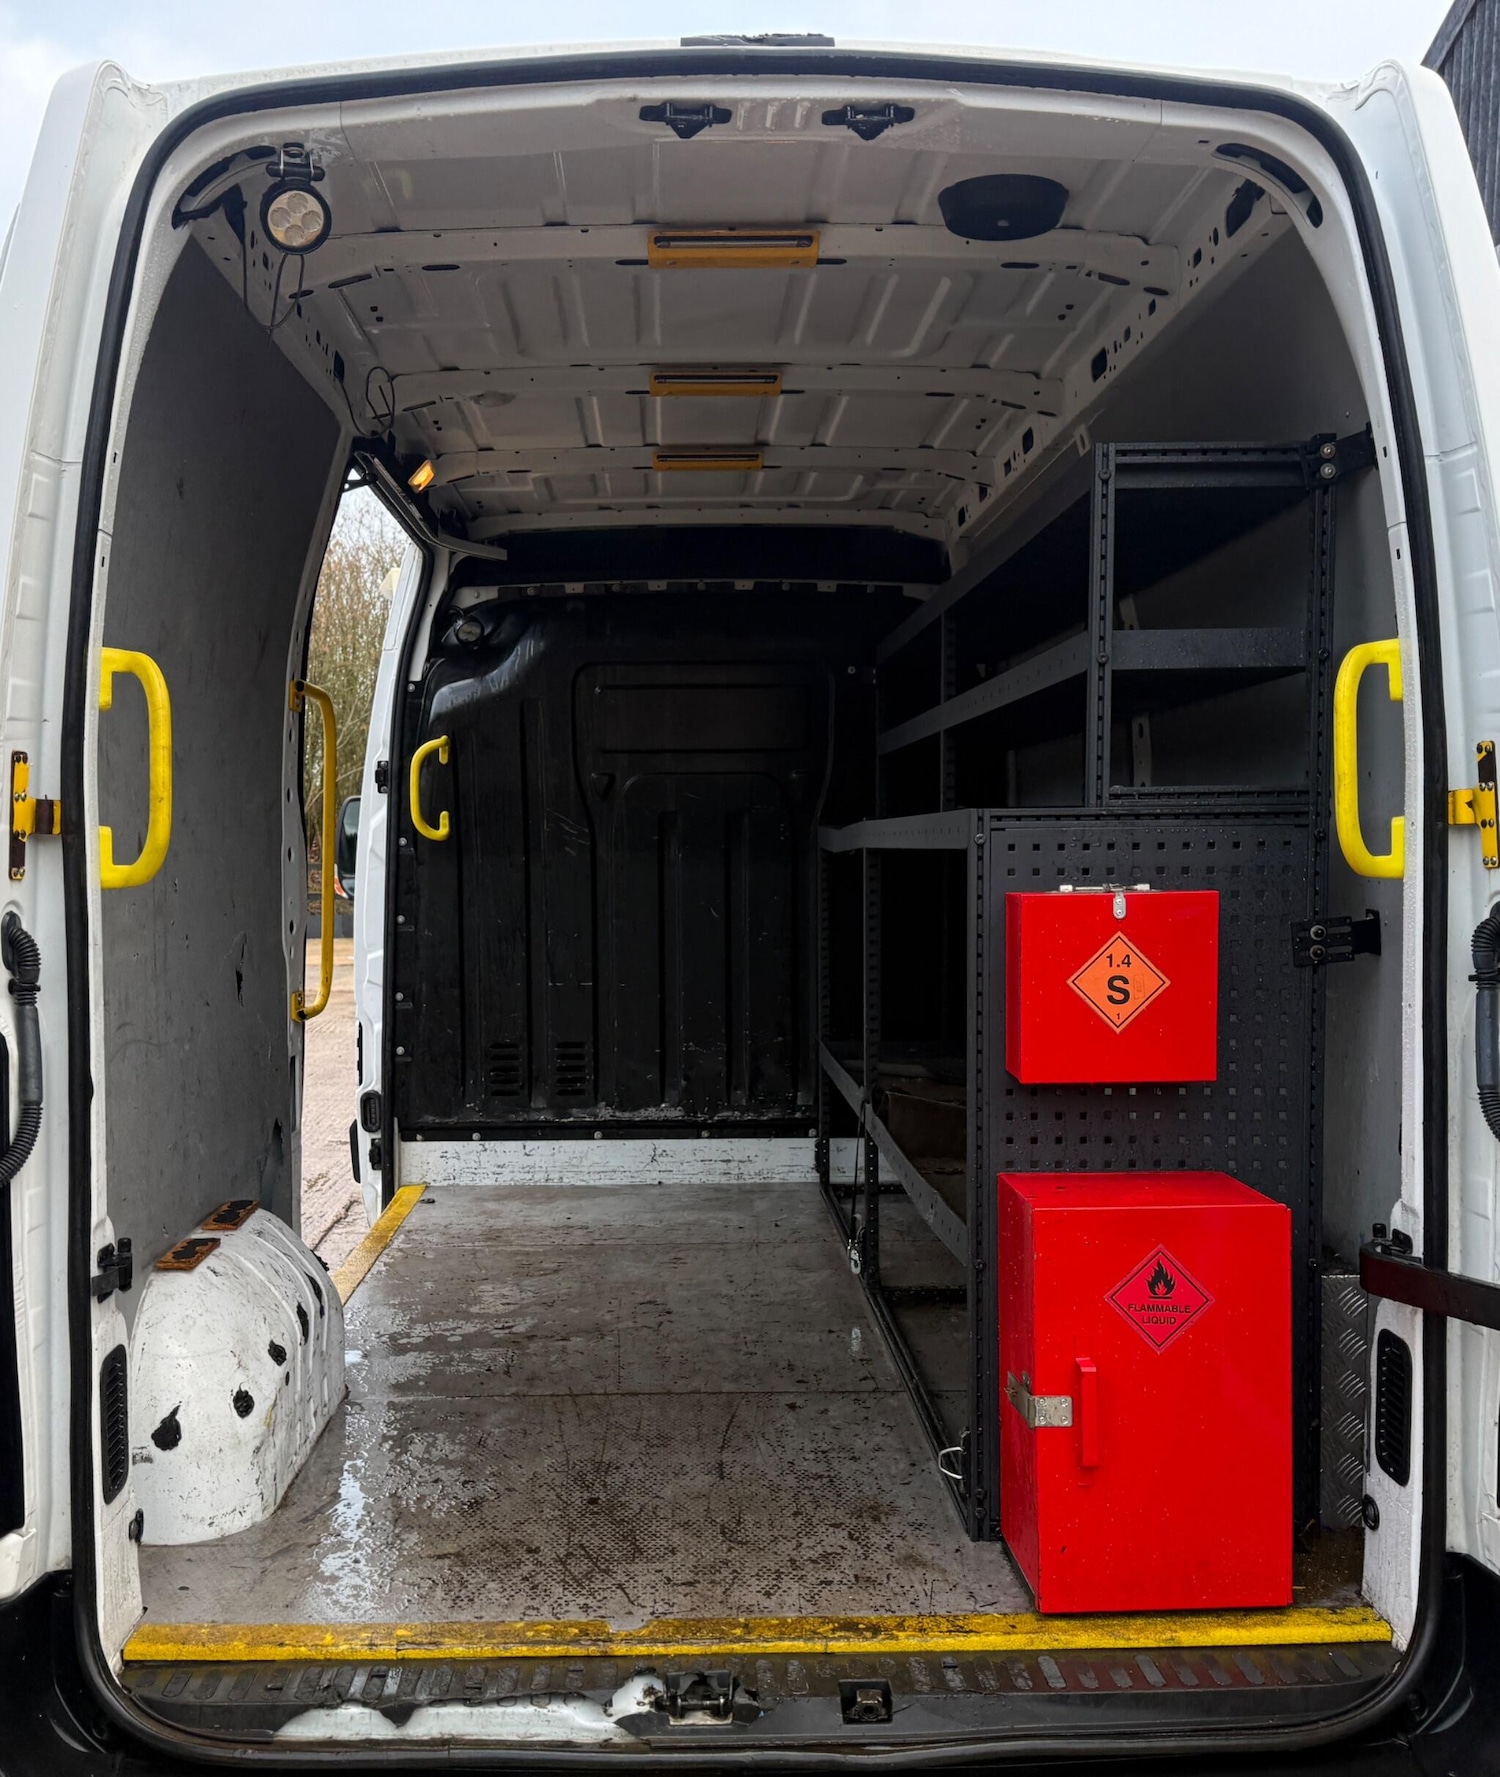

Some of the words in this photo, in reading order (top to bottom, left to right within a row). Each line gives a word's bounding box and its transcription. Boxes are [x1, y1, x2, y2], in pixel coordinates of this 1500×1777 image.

[1106, 953, 1132, 968] 1.4
[1107, 975, 1130, 1005] S
[1128, 1304, 1192, 1314] FLAMMABLE
[1142, 1316, 1177, 1325] LIQUID
